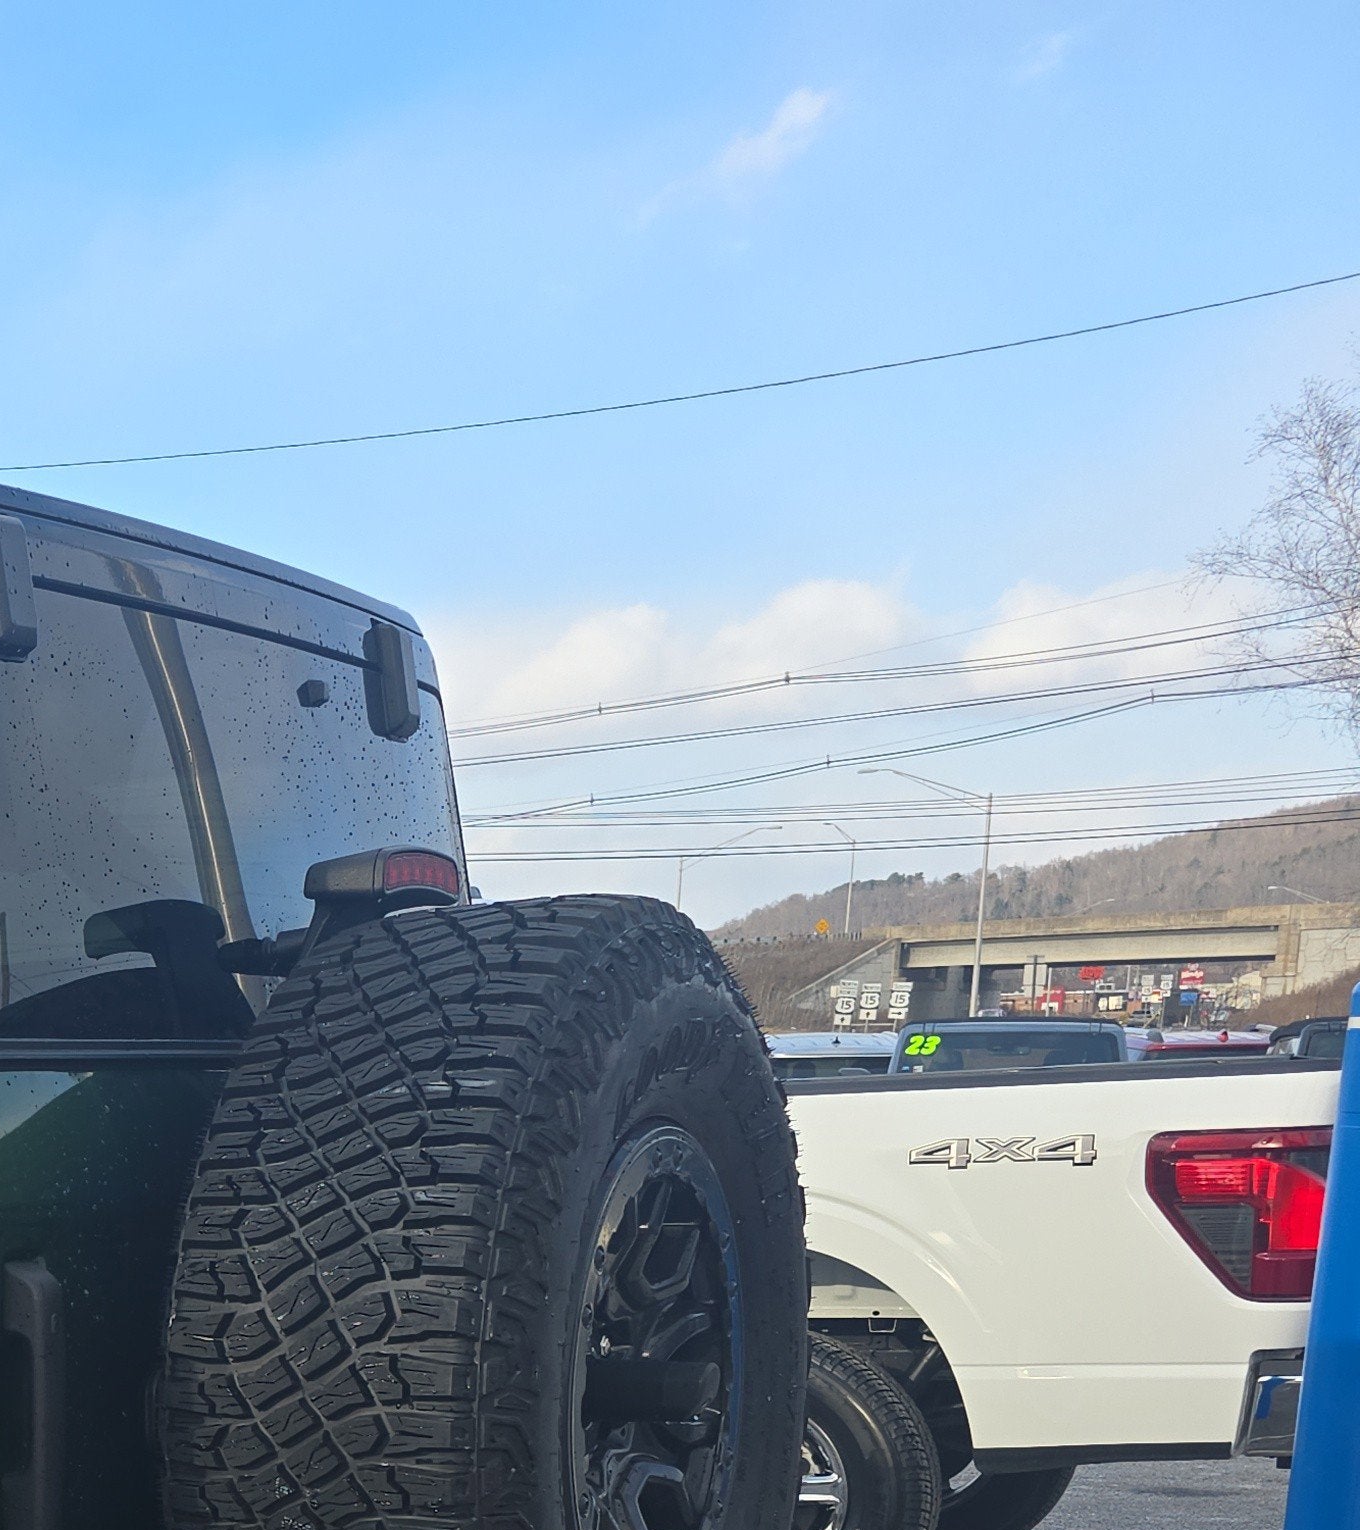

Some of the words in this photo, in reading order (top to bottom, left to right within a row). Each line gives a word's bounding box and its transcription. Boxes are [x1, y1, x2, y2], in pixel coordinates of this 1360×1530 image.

[865, 996, 876, 1005] 15
[895, 995, 906, 1004] 15
[841, 1000, 852, 1010] 15
[904, 1035, 941, 1056] 23
